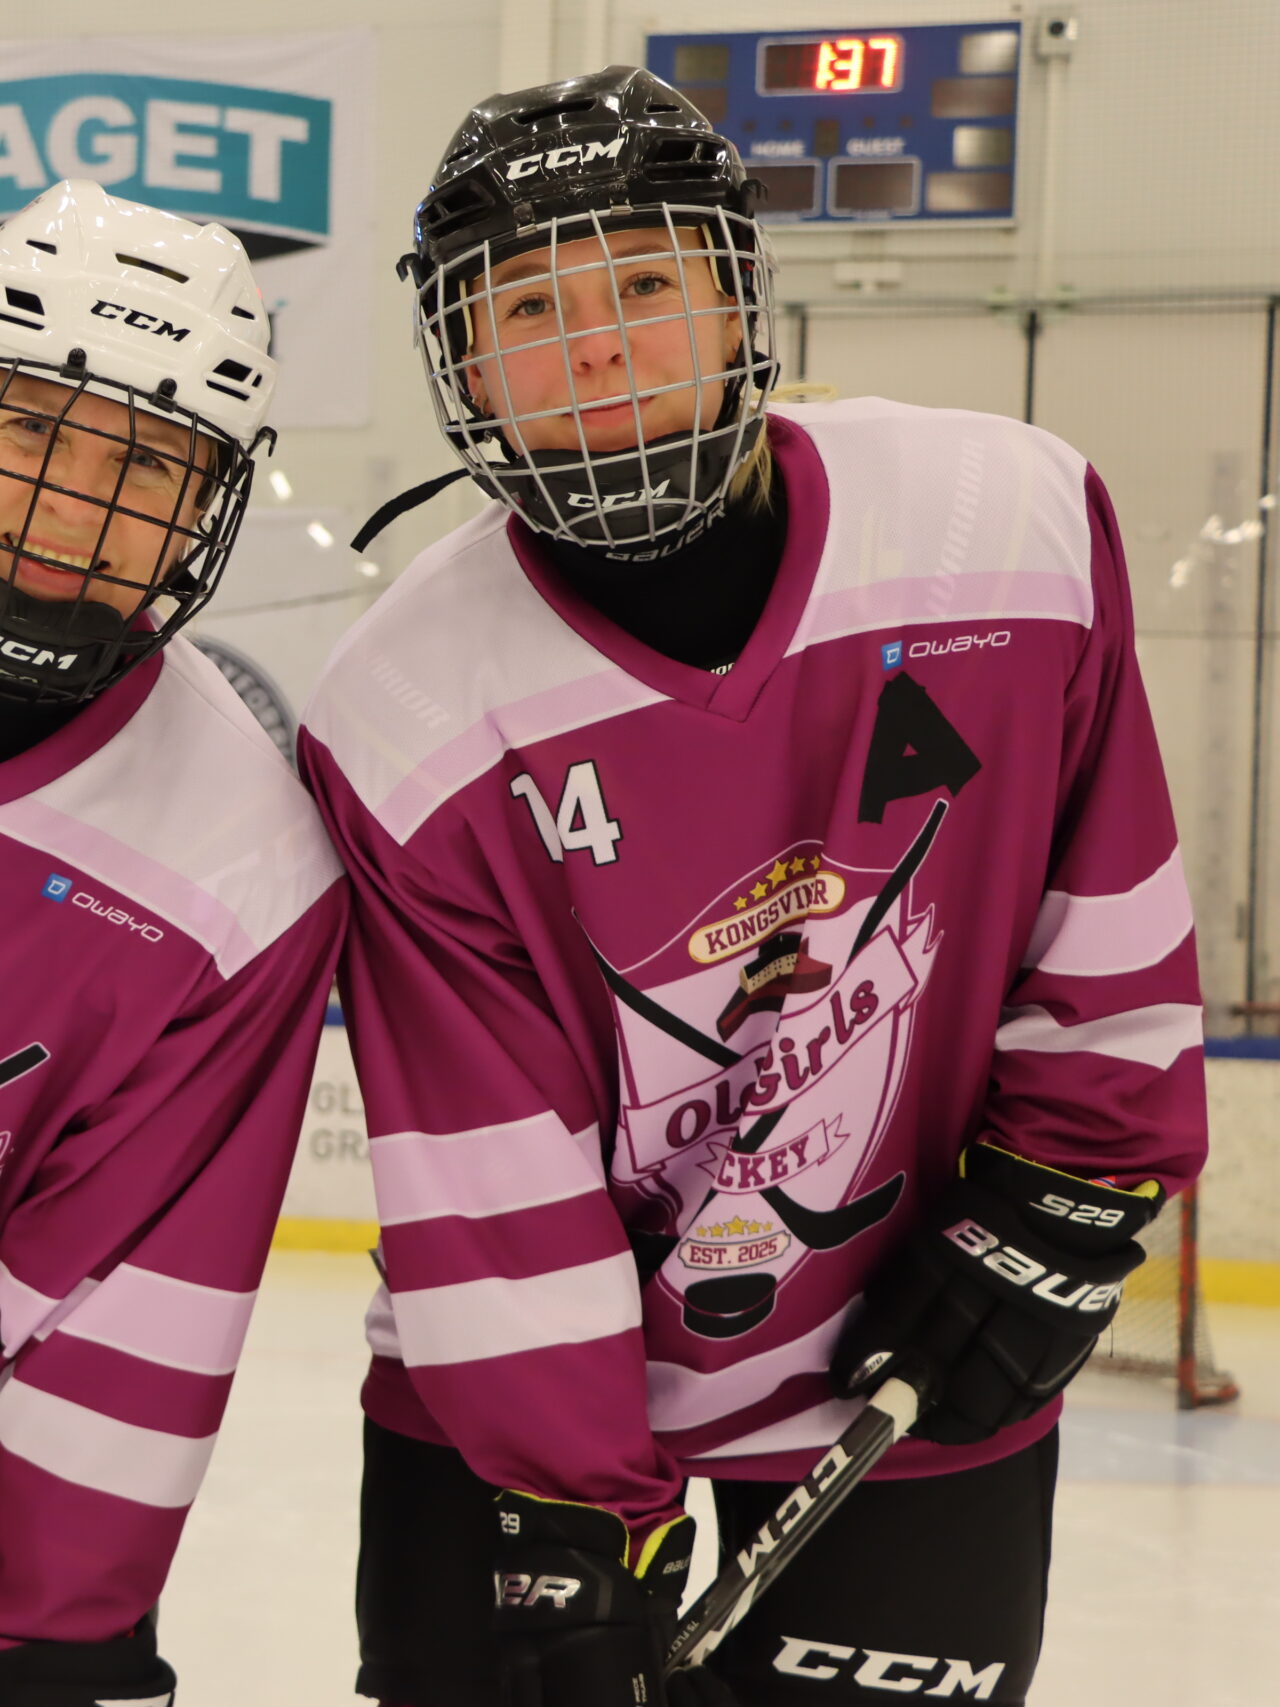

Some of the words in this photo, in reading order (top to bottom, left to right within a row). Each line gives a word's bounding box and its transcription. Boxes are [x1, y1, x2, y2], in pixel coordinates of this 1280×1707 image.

[507, 137, 624, 181] CCM
[89, 299, 191, 343] CCM
[567, 478, 671, 508] CCM
[857, 670, 983, 824] A
[509, 759, 624, 867] 14
[717, 1134, 810, 1188] CKEY
[1028, 1193, 1126, 1229] S29
[738, 1240, 779, 1262] 2025
[736, 1444, 854, 1579] CCM
[772, 1635, 1006, 1701] CCM
